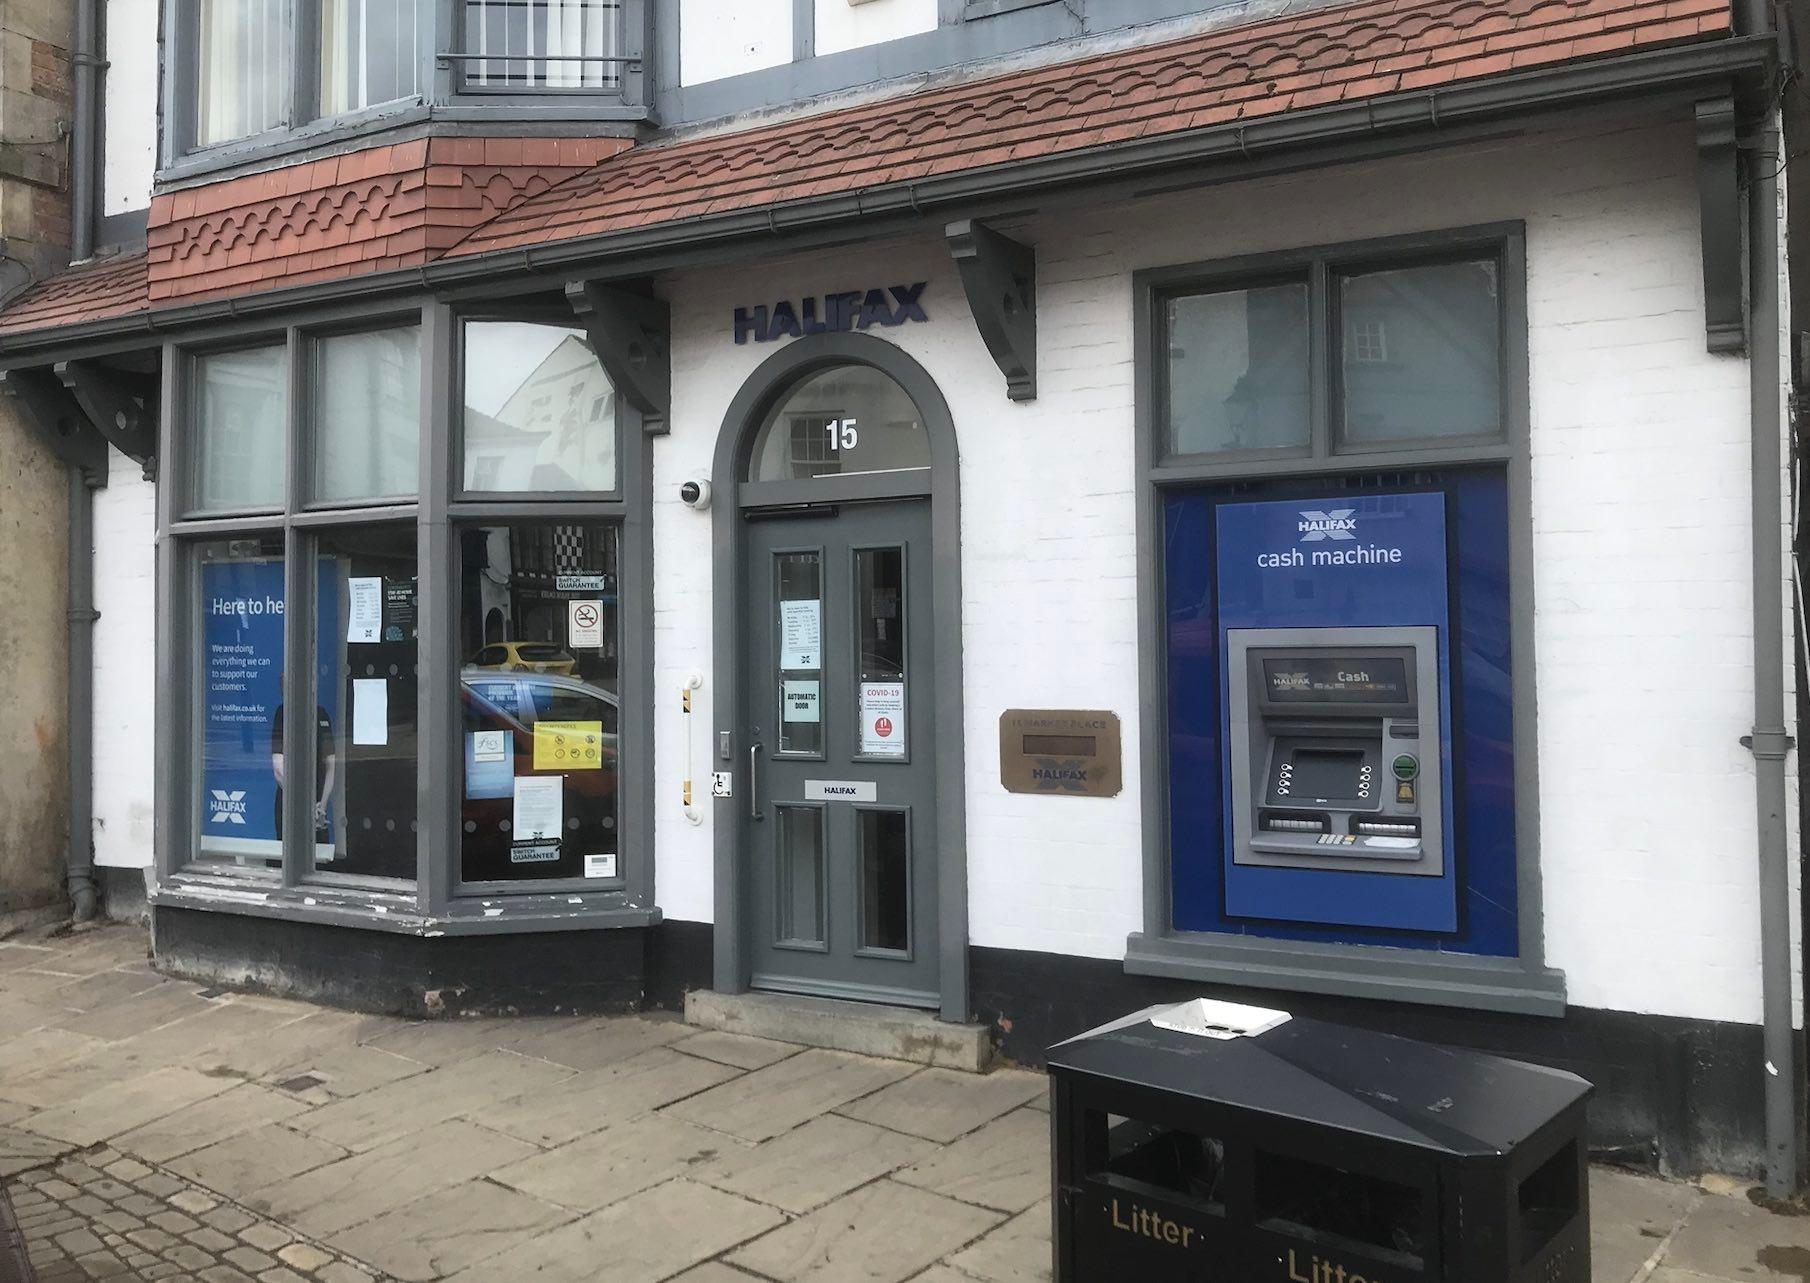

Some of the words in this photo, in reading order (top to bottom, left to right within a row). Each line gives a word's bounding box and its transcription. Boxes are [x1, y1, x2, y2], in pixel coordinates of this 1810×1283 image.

[734, 281, 928, 344] HALIFAX
[825, 418, 858, 450] 15
[1298, 519, 1356, 531] HALIFAX
[1257, 548, 1304, 567] cash
[1312, 543, 1402, 565] machine
[213, 598, 245, 615] Here
[248, 598, 263, 614] to
[266, 595, 284, 614] he
[212, 645, 222, 653] We
[235, 644, 254, 655] doing
[212, 657, 247, 668] everything
[258, 658, 271, 666] can
[212, 670, 219, 678] to
[220, 671, 245, 680] support
[1273, 678, 1310, 686] HALIFAX
[1337, 671, 1369, 682] Cash
[867, 689, 899, 697] COVID-19
[223, 704, 256, 712] halifax.co.uk
[1032, 768, 1087, 780] HALIFAX
[824, 787, 857, 795] HALIFAX
[210, 800, 247, 813] HALIFAX
[513, 852, 554, 860] GUARANTEE
[1112, 1199, 1194, 1248] Litter
[1289, 1248, 1378, 1283] Litt
